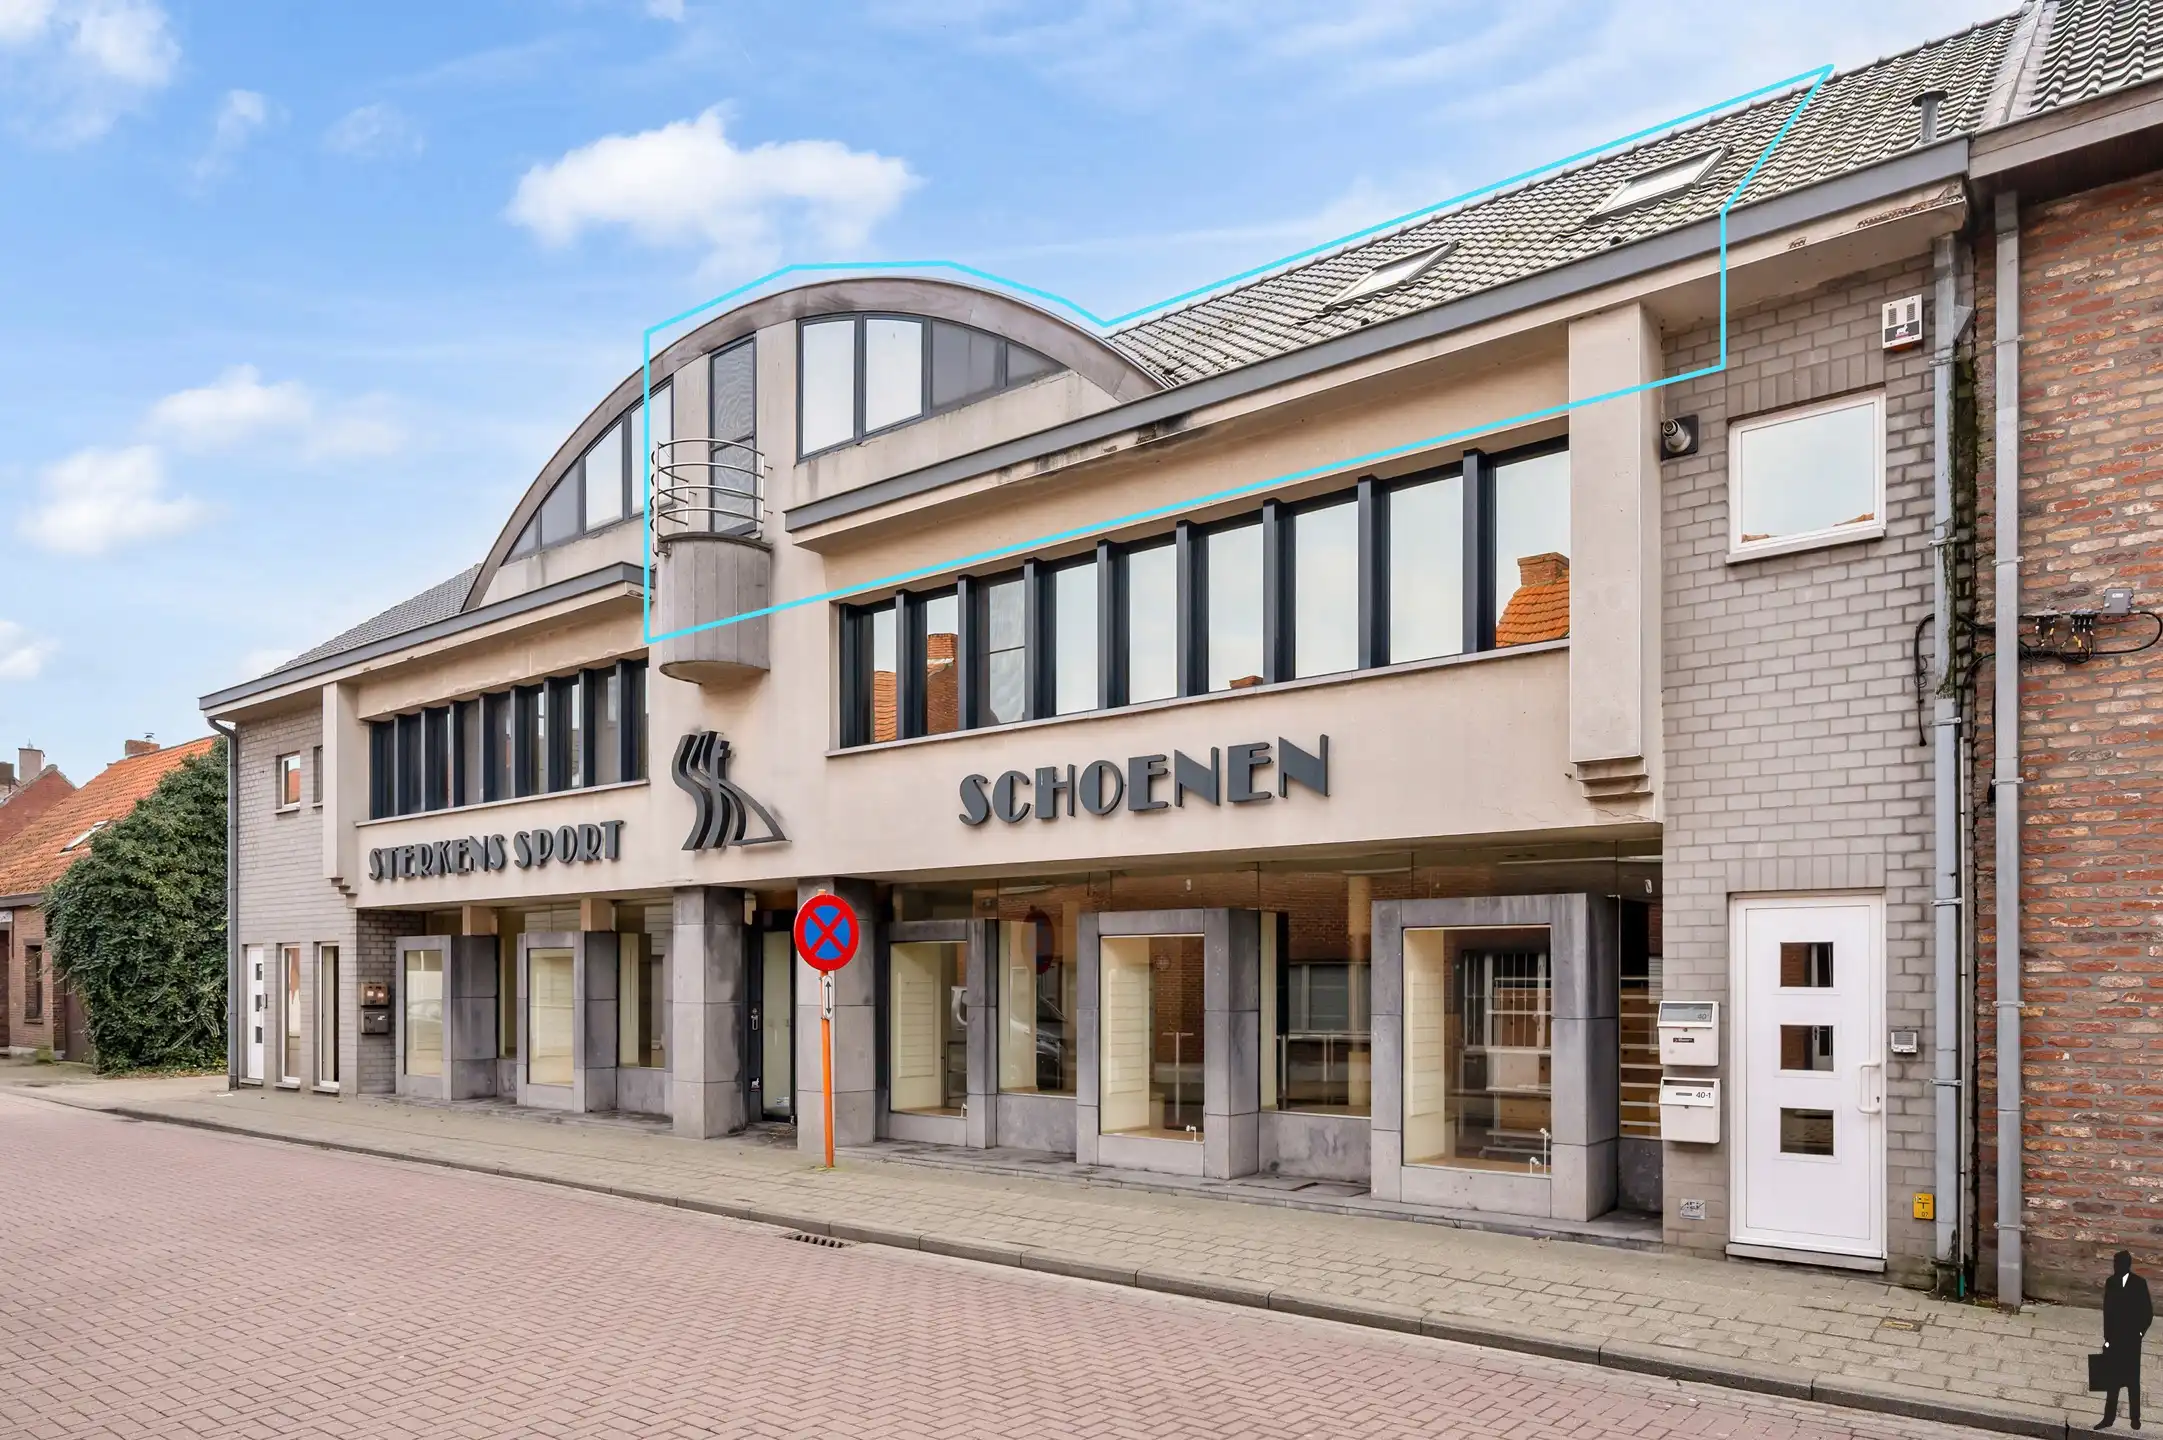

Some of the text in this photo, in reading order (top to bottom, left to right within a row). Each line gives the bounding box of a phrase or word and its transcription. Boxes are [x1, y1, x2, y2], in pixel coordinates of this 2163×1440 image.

[959, 734, 1329, 826] SCHOENEN
[369, 820, 625, 881] STERKENS SPORT
[1695, 1091, 1711, 1099] 40-1
